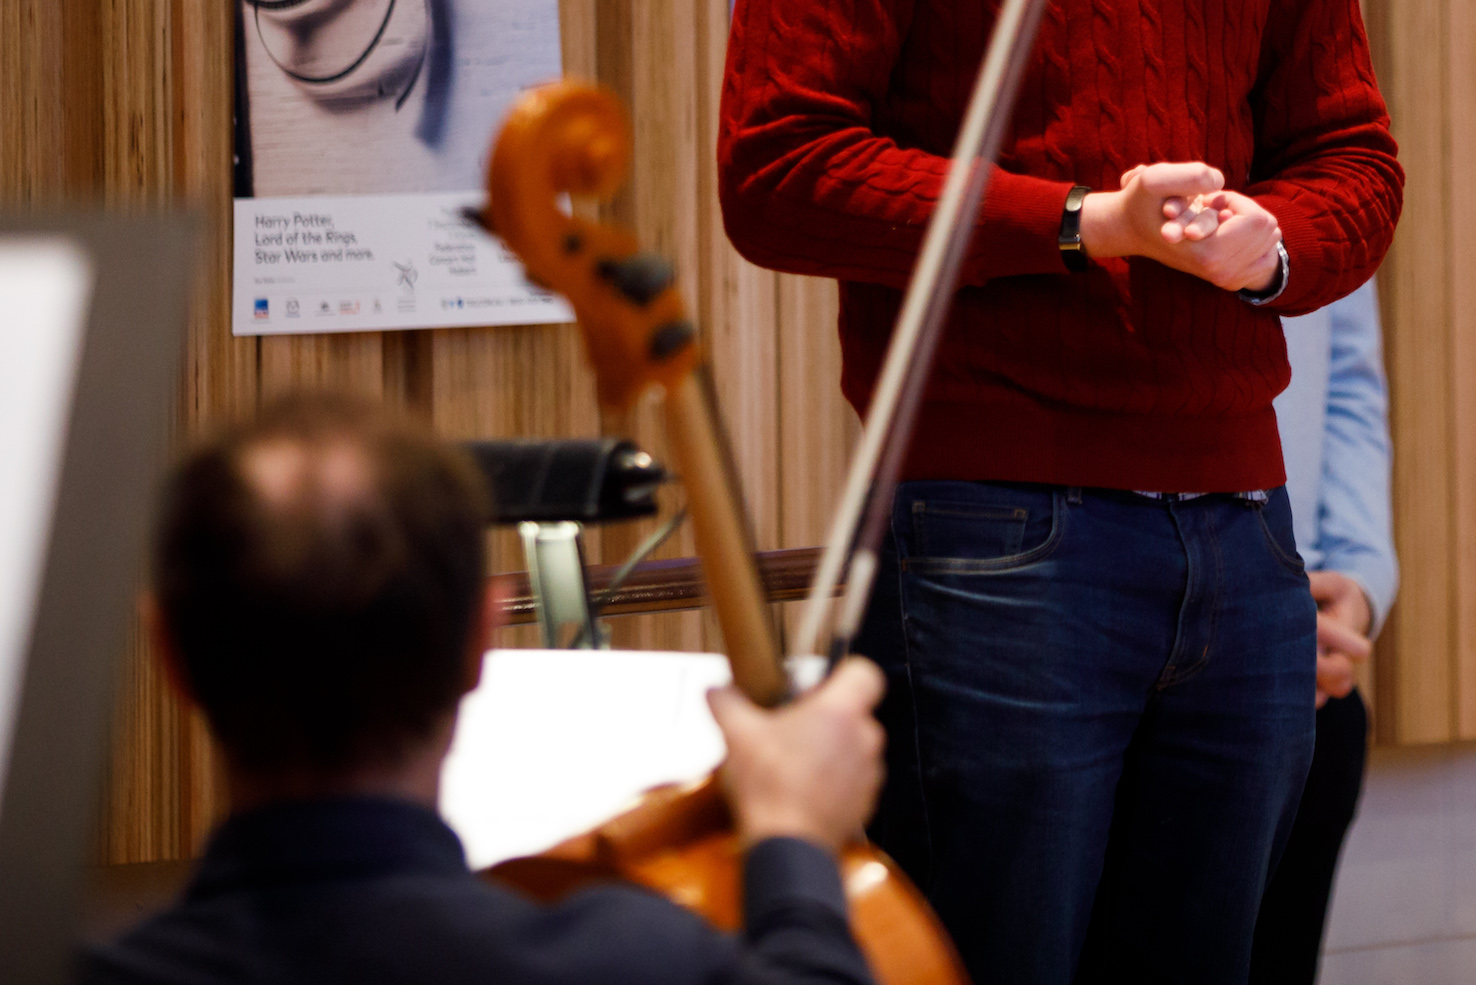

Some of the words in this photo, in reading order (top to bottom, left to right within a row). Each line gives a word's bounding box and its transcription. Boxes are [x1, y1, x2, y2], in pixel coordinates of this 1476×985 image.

[255, 214, 290, 230] Harry
[293, 211, 334, 229] Potter,
[255, 231, 282, 246] Lord
[286, 231, 299, 246] of
[302, 230, 322, 245] the
[255, 248, 281, 264] Star
[284, 247, 318, 263] Wars
[321, 247, 343, 262] and
